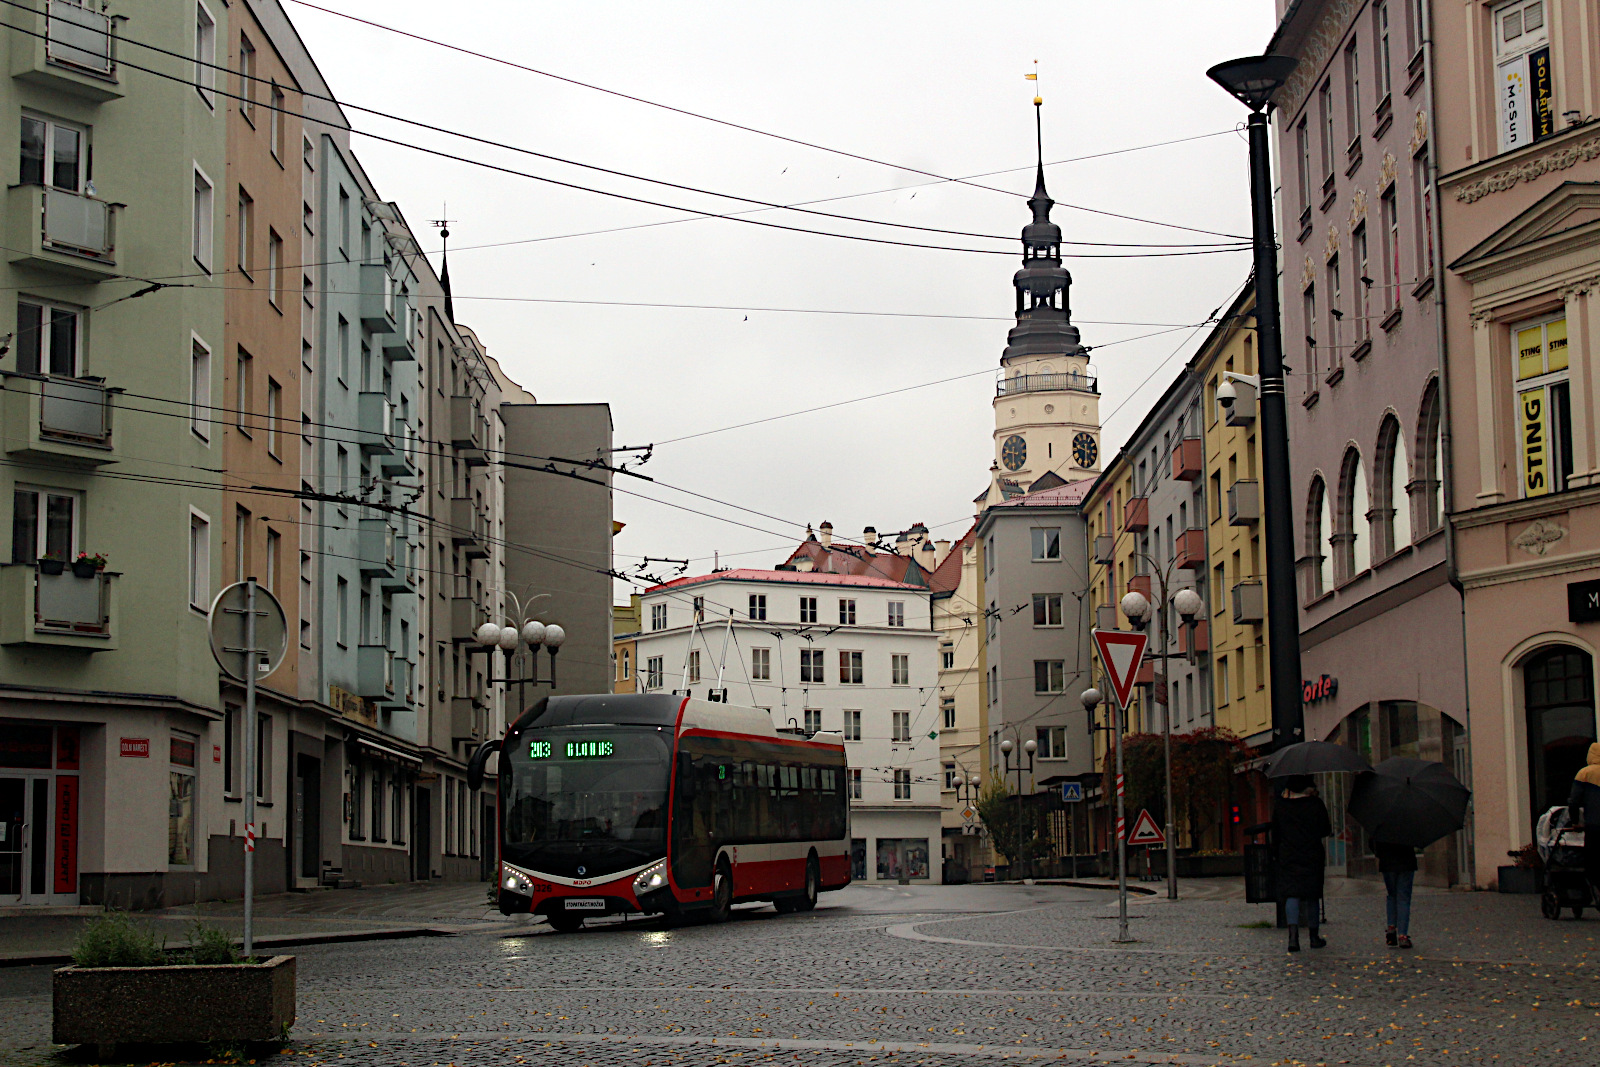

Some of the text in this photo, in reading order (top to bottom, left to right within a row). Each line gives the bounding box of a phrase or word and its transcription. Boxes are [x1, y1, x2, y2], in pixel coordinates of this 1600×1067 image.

[1507, 84, 1518, 143] McSun
[1537, 56, 1549, 136] SOLÁRIUM
[1520, 345, 1541, 358] STING
[1525, 398, 1543, 490] STING
[530, 741, 551, 758] 203
[535, 884, 552, 893] 326
